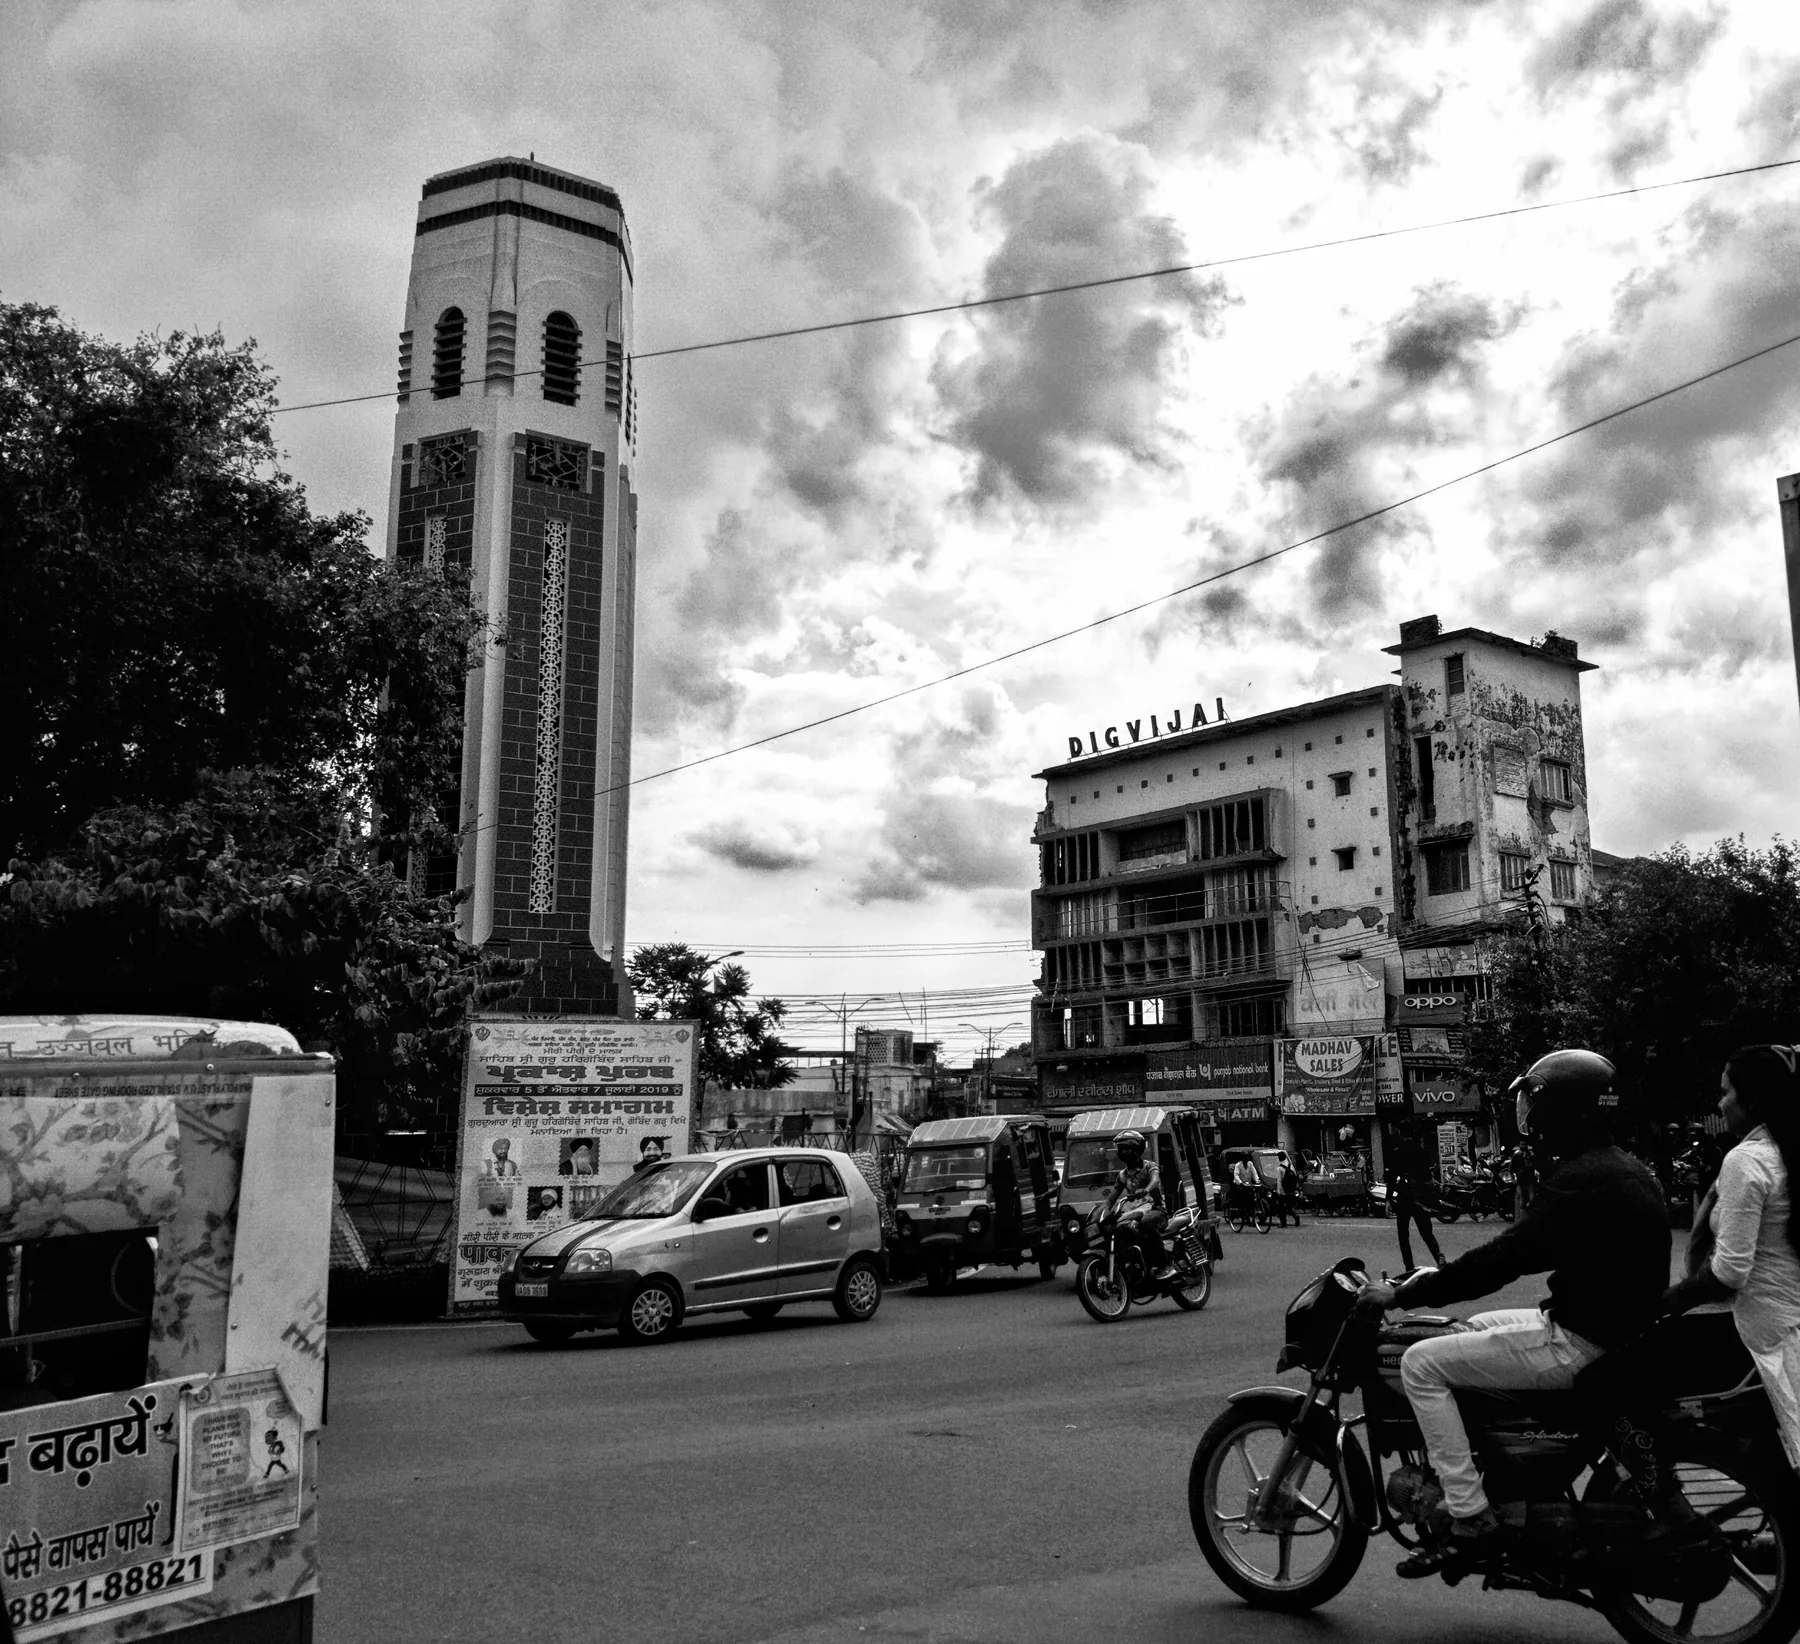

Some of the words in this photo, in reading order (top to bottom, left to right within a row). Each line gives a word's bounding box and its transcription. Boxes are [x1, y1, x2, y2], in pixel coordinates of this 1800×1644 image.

[1068, 697, 1226, 758] DIGVIJAI
[1404, 996, 1457, 1009] oppo
[36, 1037, 136, 1056] उज्जवल
[1301, 1040, 1353, 1056] MADHAV
[1310, 1058, 1343, 1073] SALES
[103, 1085, 138, 1097] ROOFING
[524, 1086, 533, 1094] 5
[1414, 1088, 1456, 1102] vivo
[1231, 1107, 1265, 1118] ATM
[28, 1396, 156, 1487] बढ़ायें
[201, 1459, 230, 1470] CHOOSE
[4, 1531, 43, 1579] पैसे
[48, 1525, 110, 1569] वापस
[115, 1502, 160, 1551] पायें
